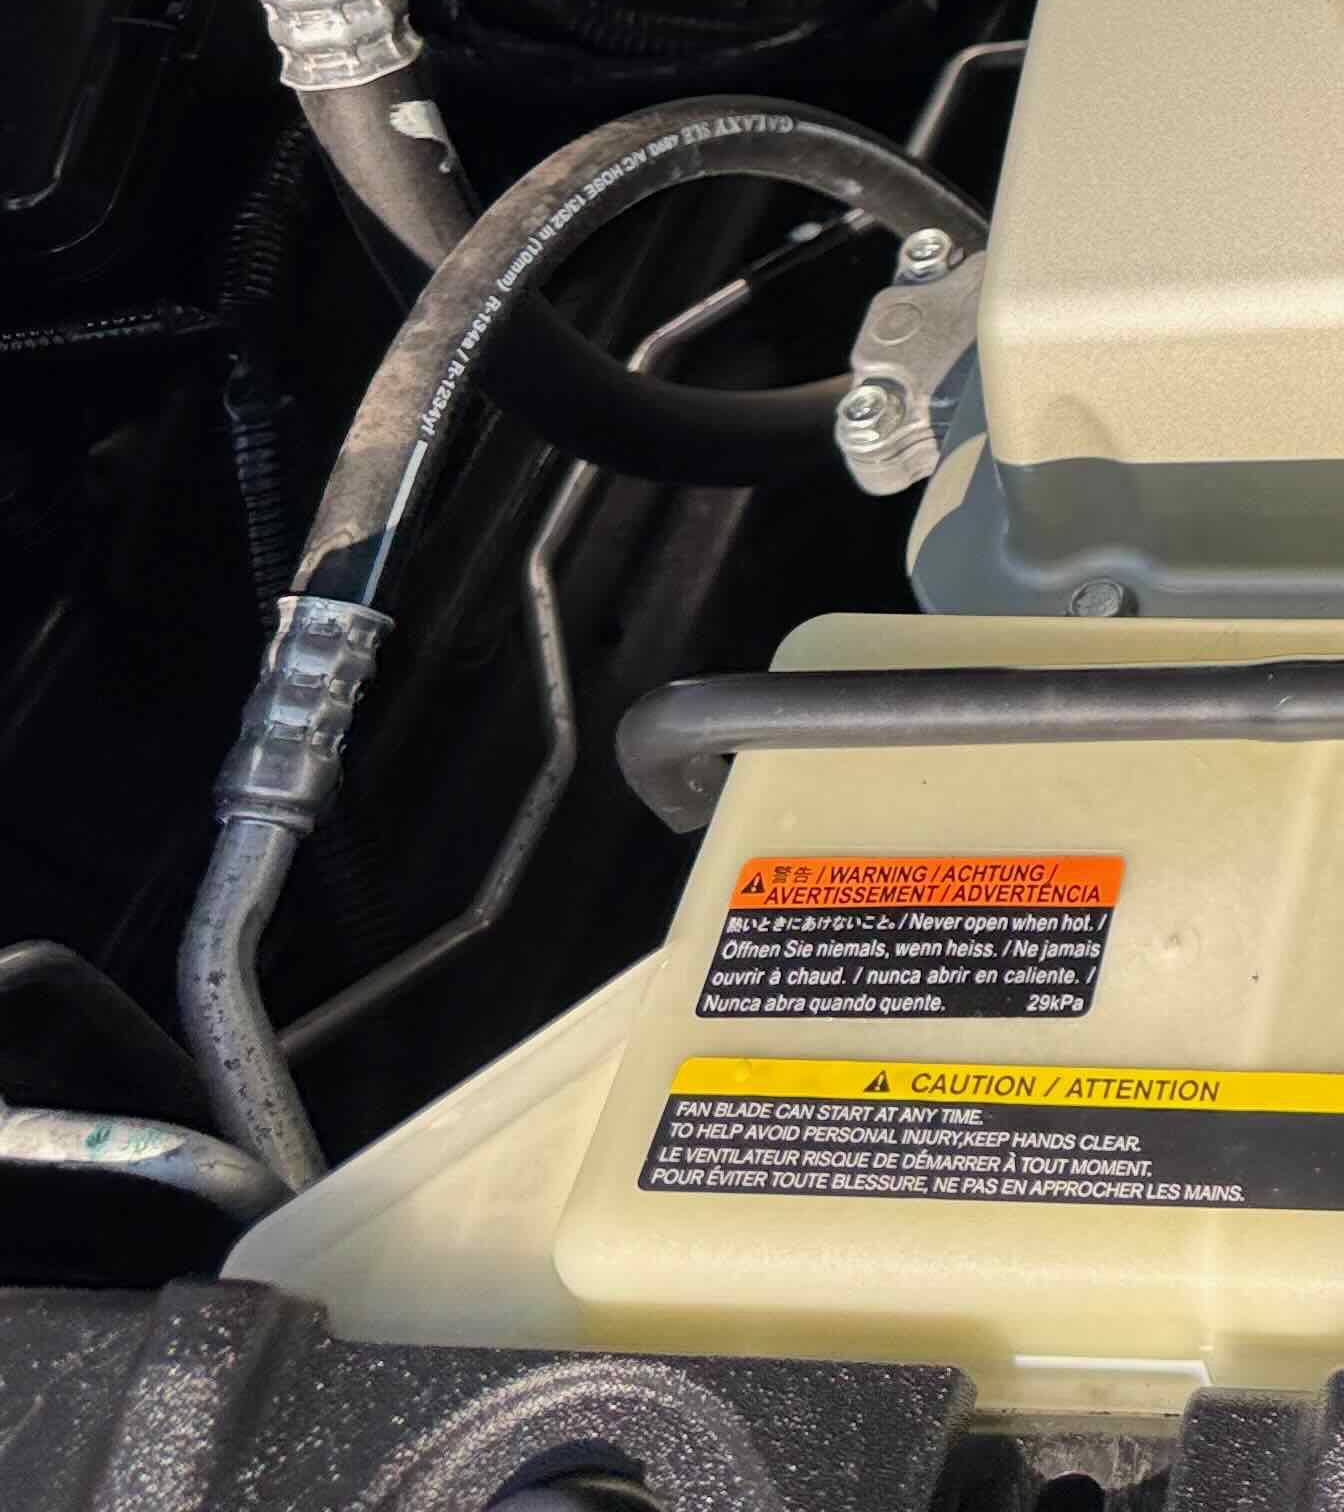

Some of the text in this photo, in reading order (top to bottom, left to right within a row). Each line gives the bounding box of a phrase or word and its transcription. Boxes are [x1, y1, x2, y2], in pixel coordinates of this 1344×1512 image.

[715, 113, 795, 136] GALAXY
[619, 145, 647, 172] A/C
[582, 163, 623, 196] HOSE
[496, 235, 543, 293] (10mm)
[461, 294, 501, 351] R-134a
[771, 863, 1059, 884] 警告 / WARNING / ACHTUNG /
[763, 885, 941, 905] AVERTISSEMENT
[909, 913, 964, 931] Never
[964, 915, 1009, 935] open
[1011, 914, 1058, 931] when
[1061, 914, 1095, 931] hot.
[1097, 914, 1108, 931] /
[784, 939, 814, 958] Sie
[815, 939, 891, 959] niemals,
[895, 942, 942, 958] wenn
[945, 939, 999, 958] heiss.
[1001, 940, 1012, 958] /
[1013, 941, 1040, 958] Ne
[1039, 941, 1101, 962] jamais
[711, 968, 765, 986] ouvrir
[786, 966, 847, 985] chaud.
[852, 967, 864, 985] /
[866, 970, 921, 985] nunca
[926, 967, 971, 985] abrir
[975, 970, 999, 984] en
[1003, 967, 1081, 985] caliente.
[1085, 967, 1097, 985] /
[702, 994, 946, 1015] Nunca abra quando quente.
[1025, 993, 1085, 1012] 29kPa
[911, 1072, 1221, 1102] CAUTION / ATTENTION
[675, 1101, 984, 1125] FAN BLADE CAN START AT ANY TIME.
[669, 1122, 693, 1138] TO
[696, 1123, 743, 1140] HELP
[743, 1124, 800, 1141] AVOID
[802, 1126, 898, 1144] PERSONAL
[1011, 1133, 1077, 1150] HANDS
[1079, 1135, 1142, 1152] CLEAR.
[658, 1146, 1153, 1177] LE VENTILATEUR RISQUE DE DÉMARRER À TOUT MOMENT.
[650, 1164, 1246, 1202] POUR ÉVITER TOUTE BLESSURE, NE PAS EN APPROCHER LES MAINS.
